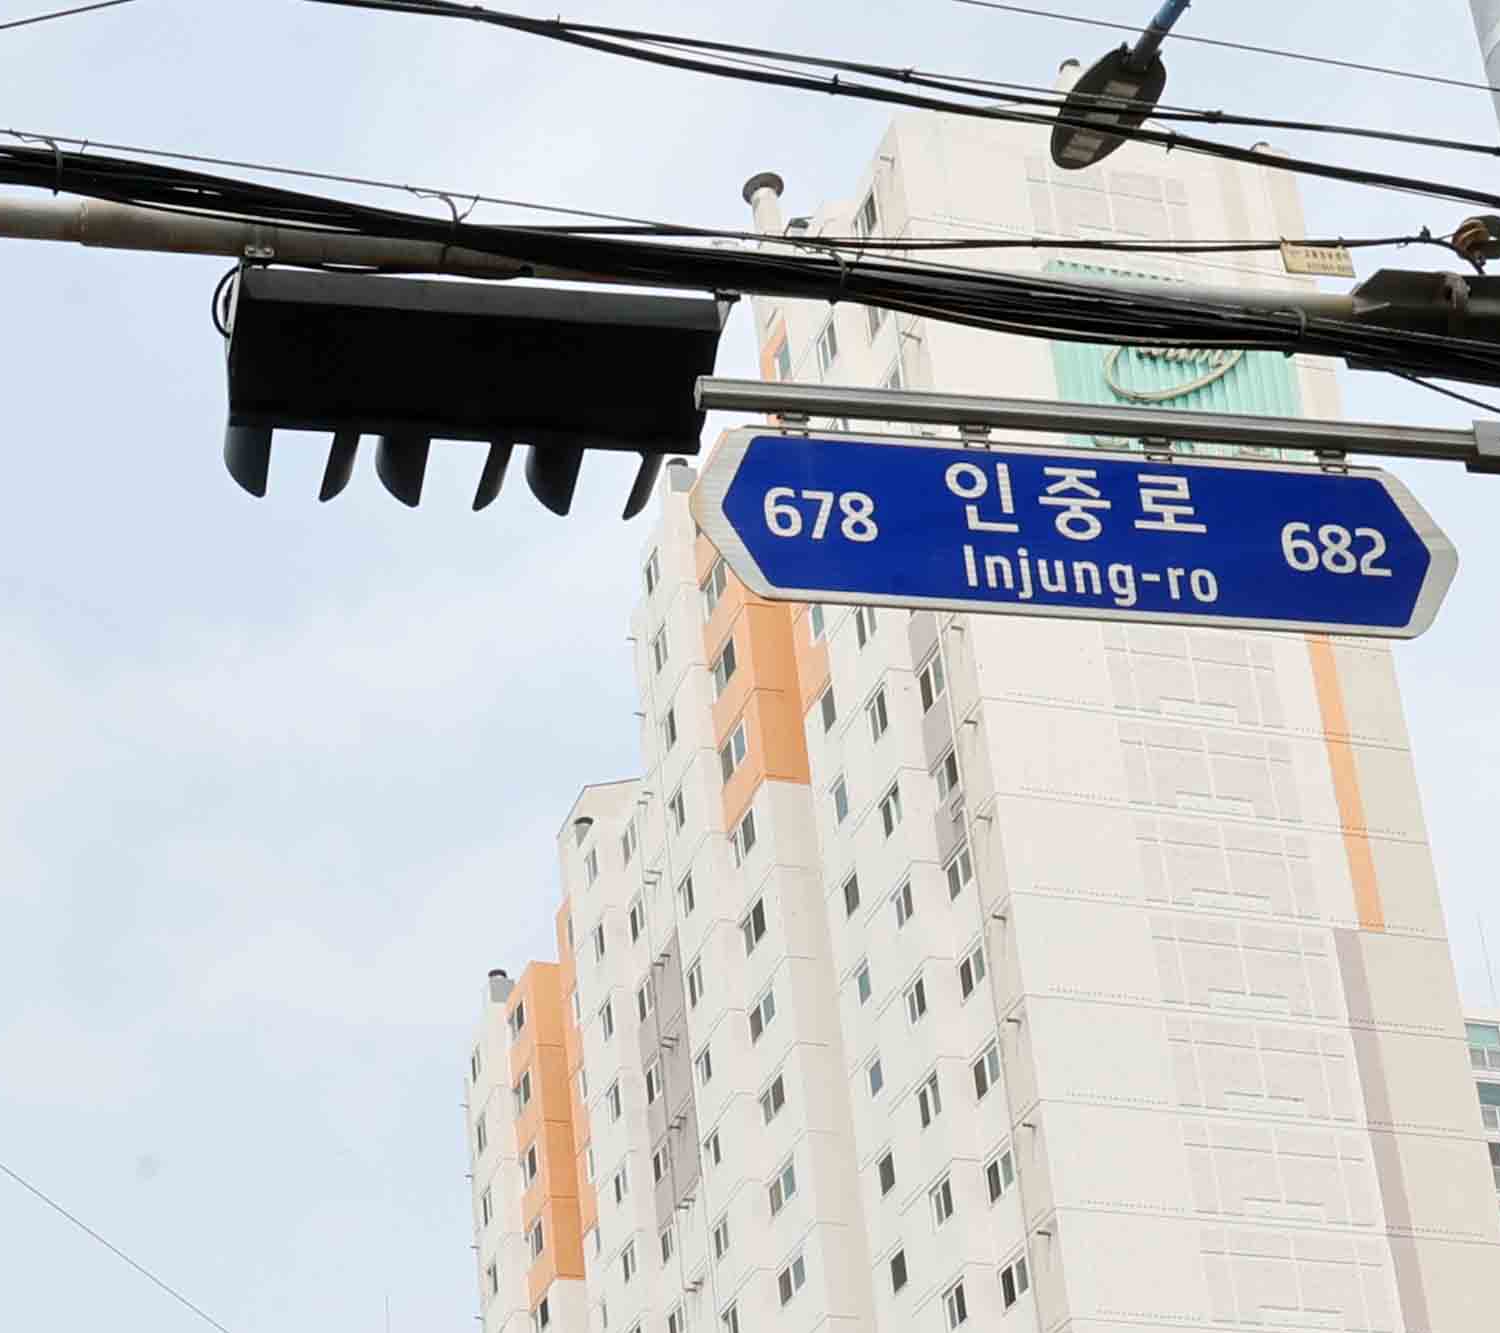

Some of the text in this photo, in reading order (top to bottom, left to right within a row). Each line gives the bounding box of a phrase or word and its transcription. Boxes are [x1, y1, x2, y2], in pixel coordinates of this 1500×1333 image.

[764, 487, 879, 543] 678
[944, 461, 1208, 542] 인중로
[962, 544, 1220, 608] Injung-ro
[1279, 520, 1393, 578] 682
